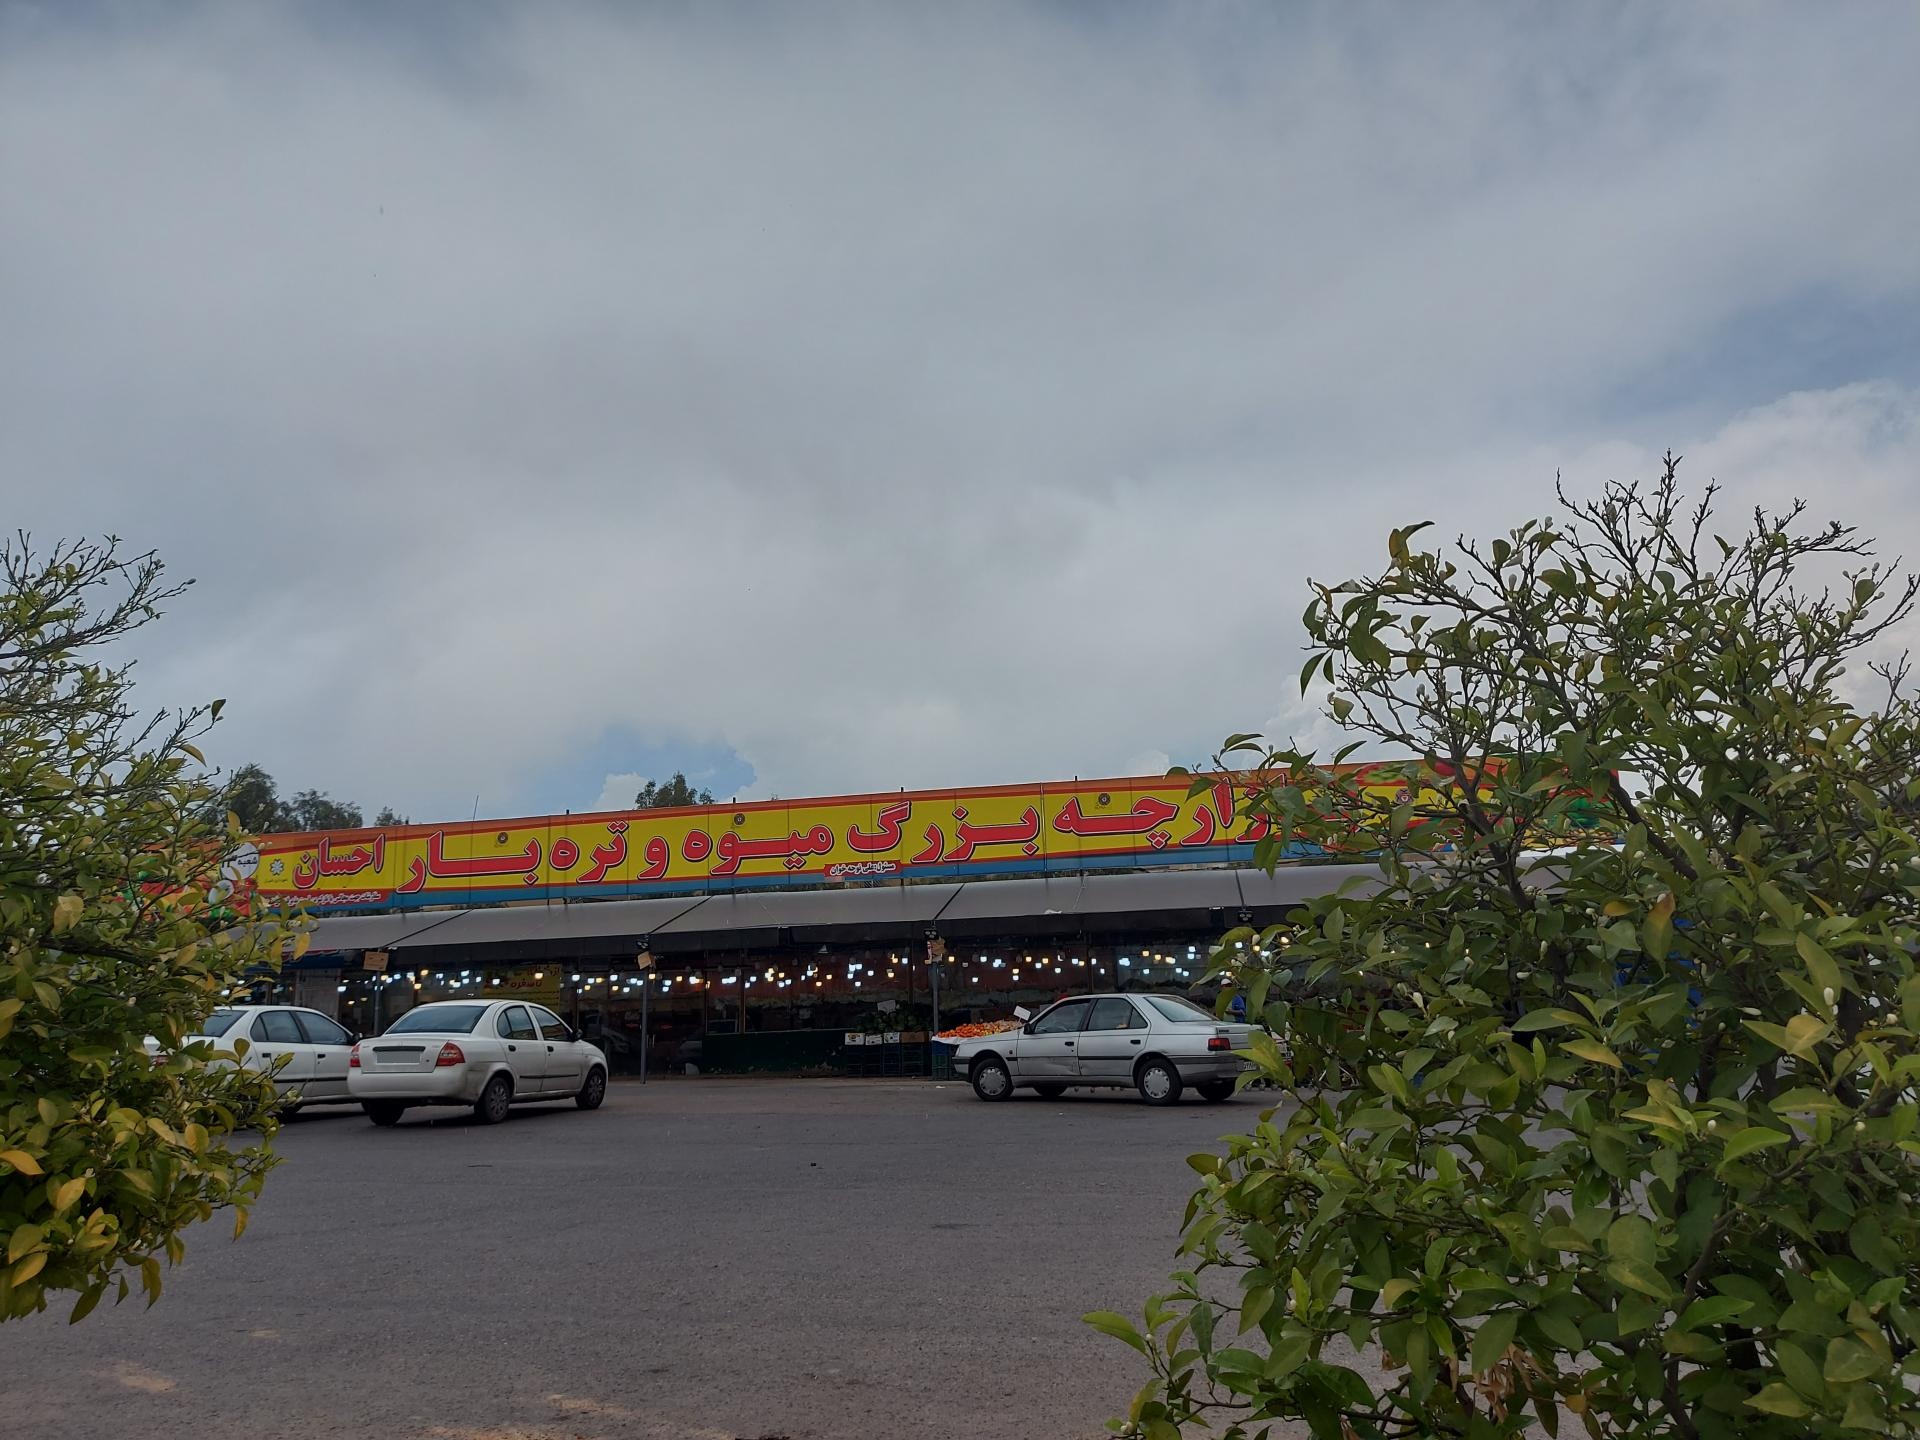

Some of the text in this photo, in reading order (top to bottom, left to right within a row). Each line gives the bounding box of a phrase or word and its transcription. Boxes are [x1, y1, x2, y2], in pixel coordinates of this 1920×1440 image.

[292, 833, 387, 889] احسان
[396, 830, 542, 894] بار
[549, 820, 630, 885] تره
[638, 835, 670, 881] و
[681, 823, 834, 877] میوه
[847, 800, 1041, 864] بزرگ
